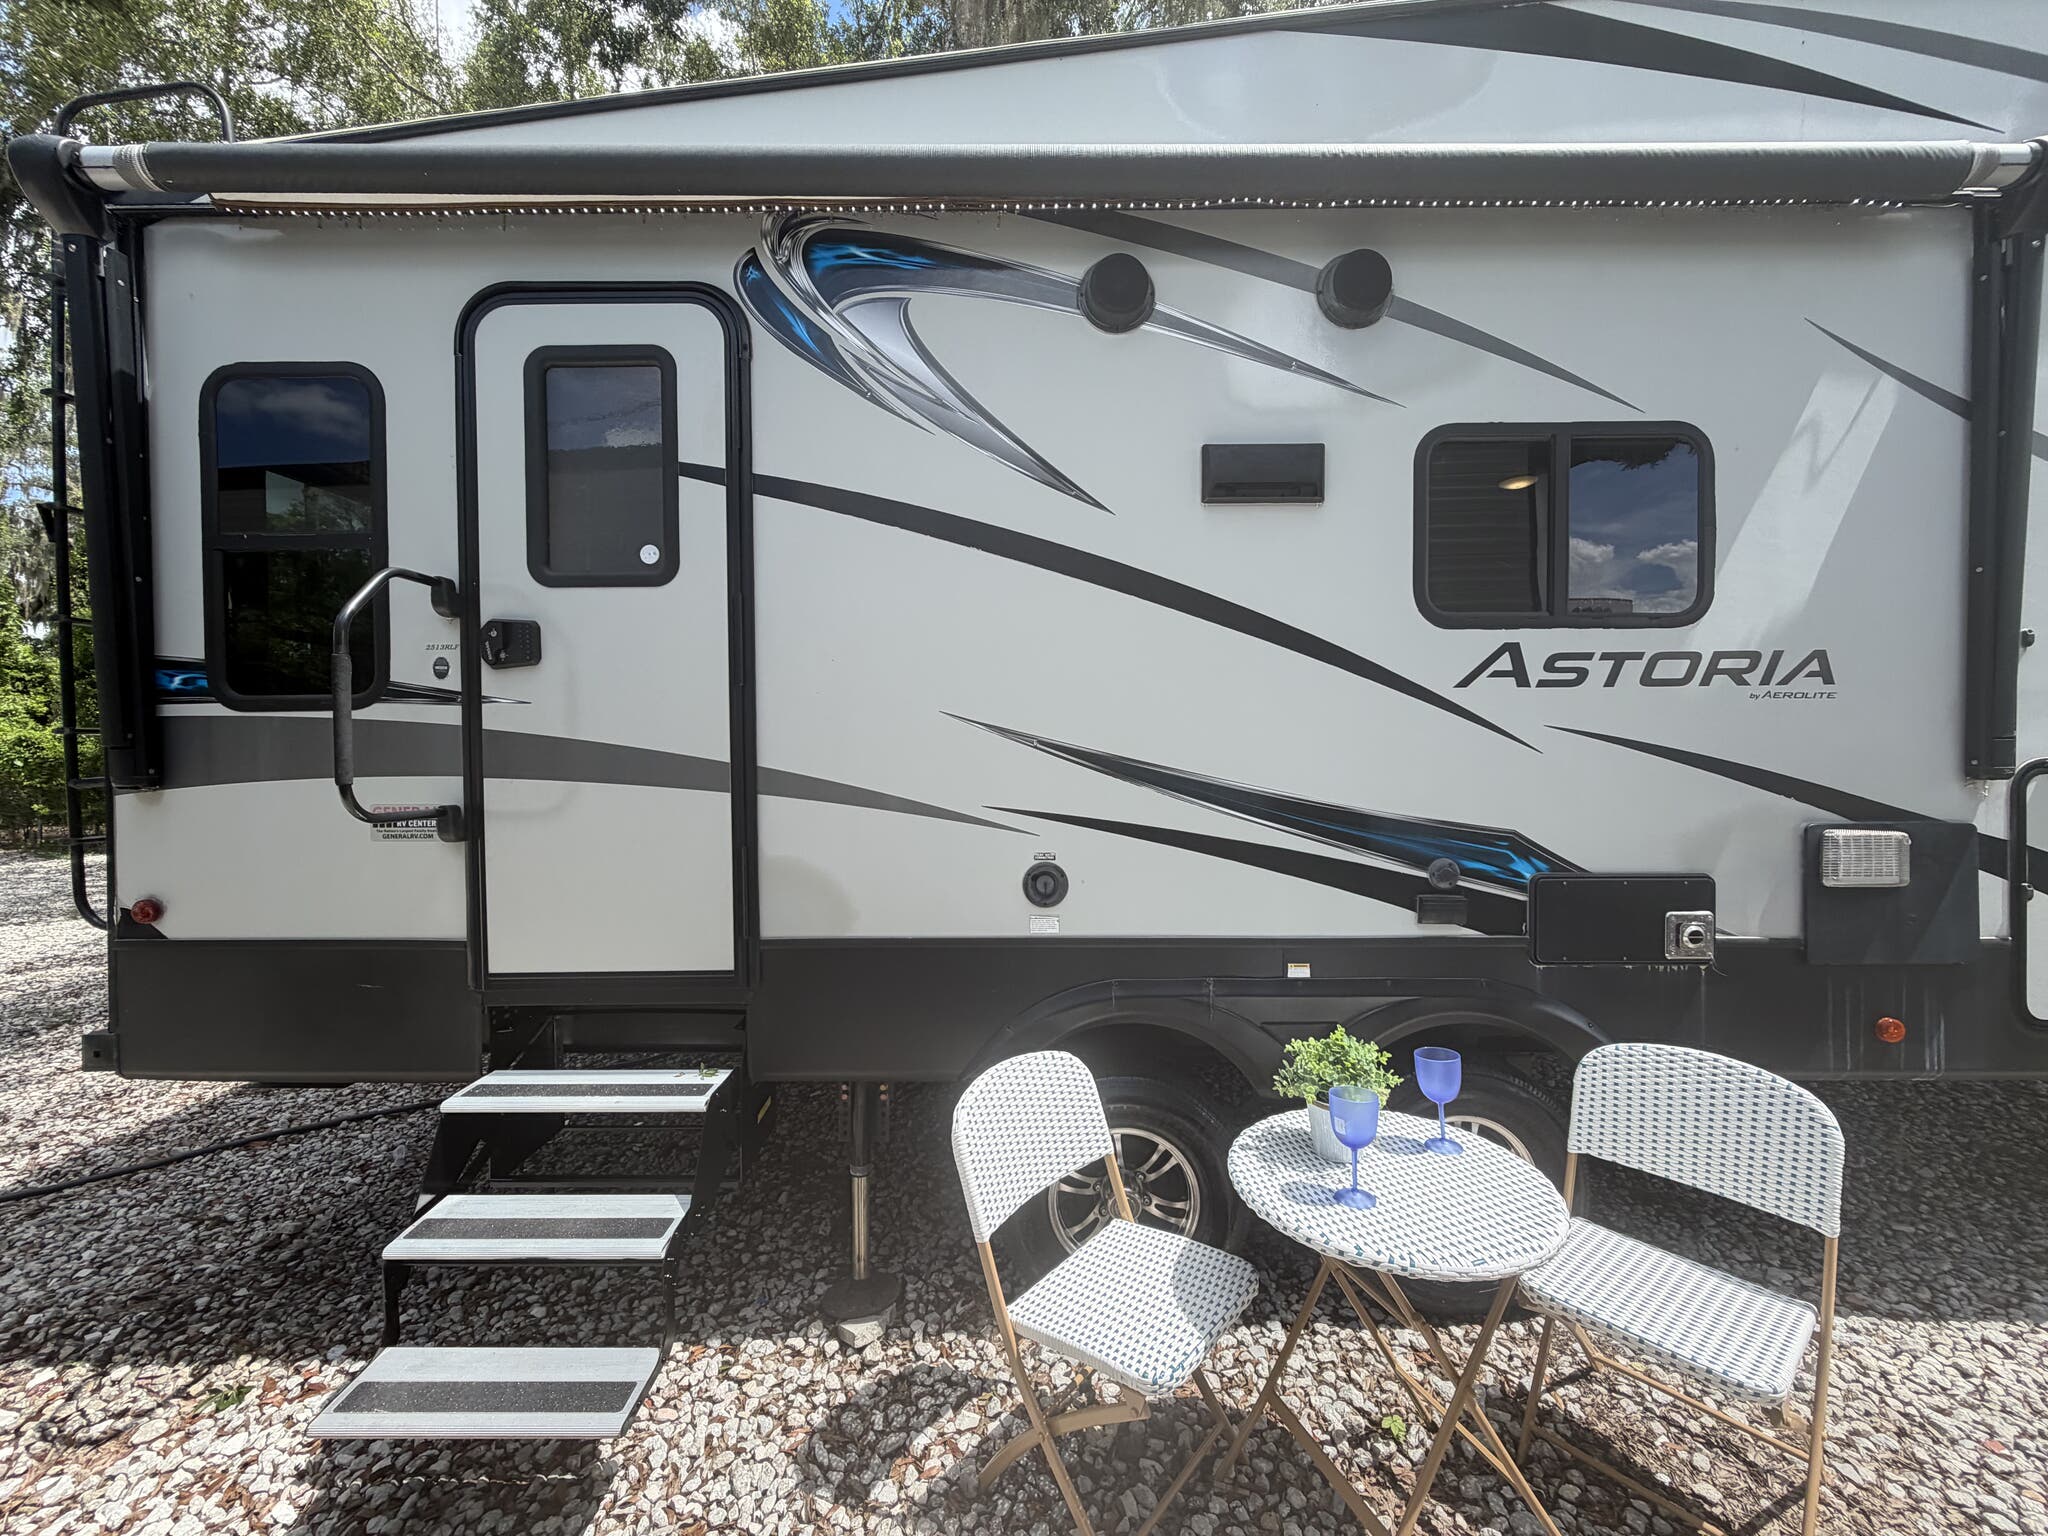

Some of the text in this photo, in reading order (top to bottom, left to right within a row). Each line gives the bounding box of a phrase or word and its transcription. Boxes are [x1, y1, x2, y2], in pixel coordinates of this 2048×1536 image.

[1452, 642, 1836, 689] ASTORIA
[1749, 690, 1838, 700] by AEROLITE
[408, 819, 437, 827] CENTER
